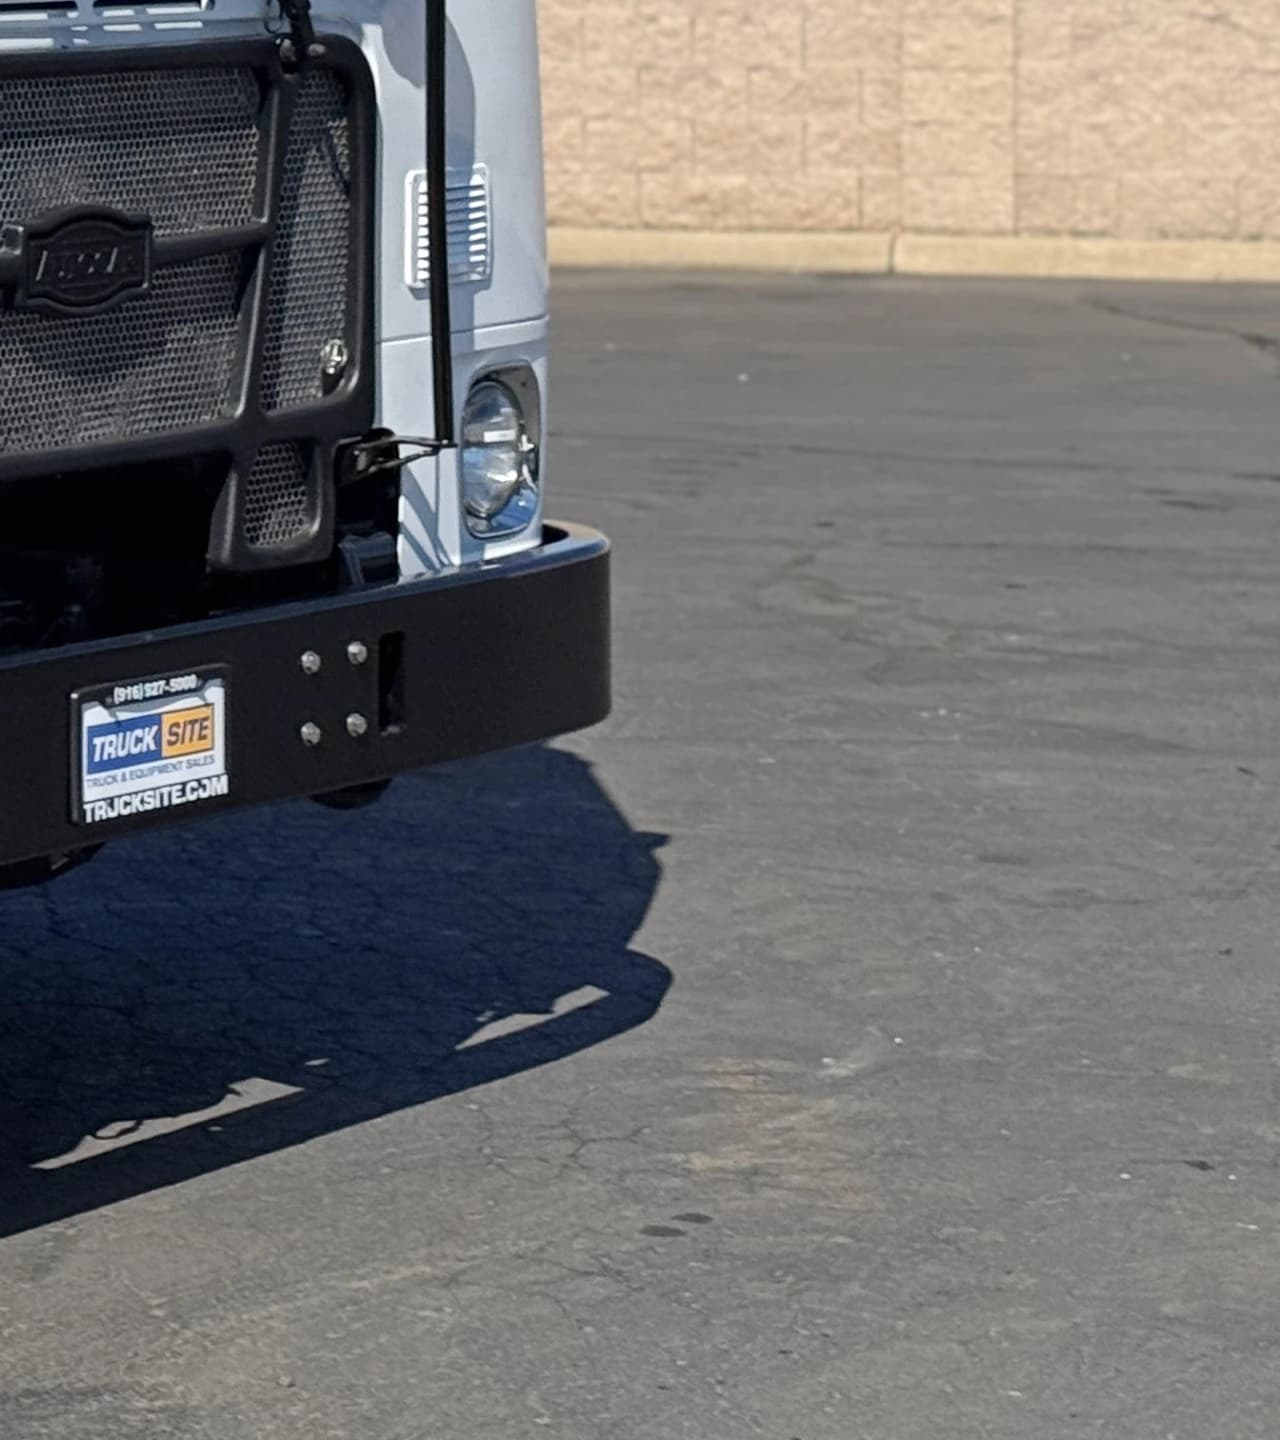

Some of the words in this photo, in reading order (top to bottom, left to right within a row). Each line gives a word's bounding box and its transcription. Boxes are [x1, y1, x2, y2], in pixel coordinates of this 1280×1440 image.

[93, 725, 160, 762] TRUCK
[167, 715, 210, 746] SITE
[185, 754, 216, 769] SALES
